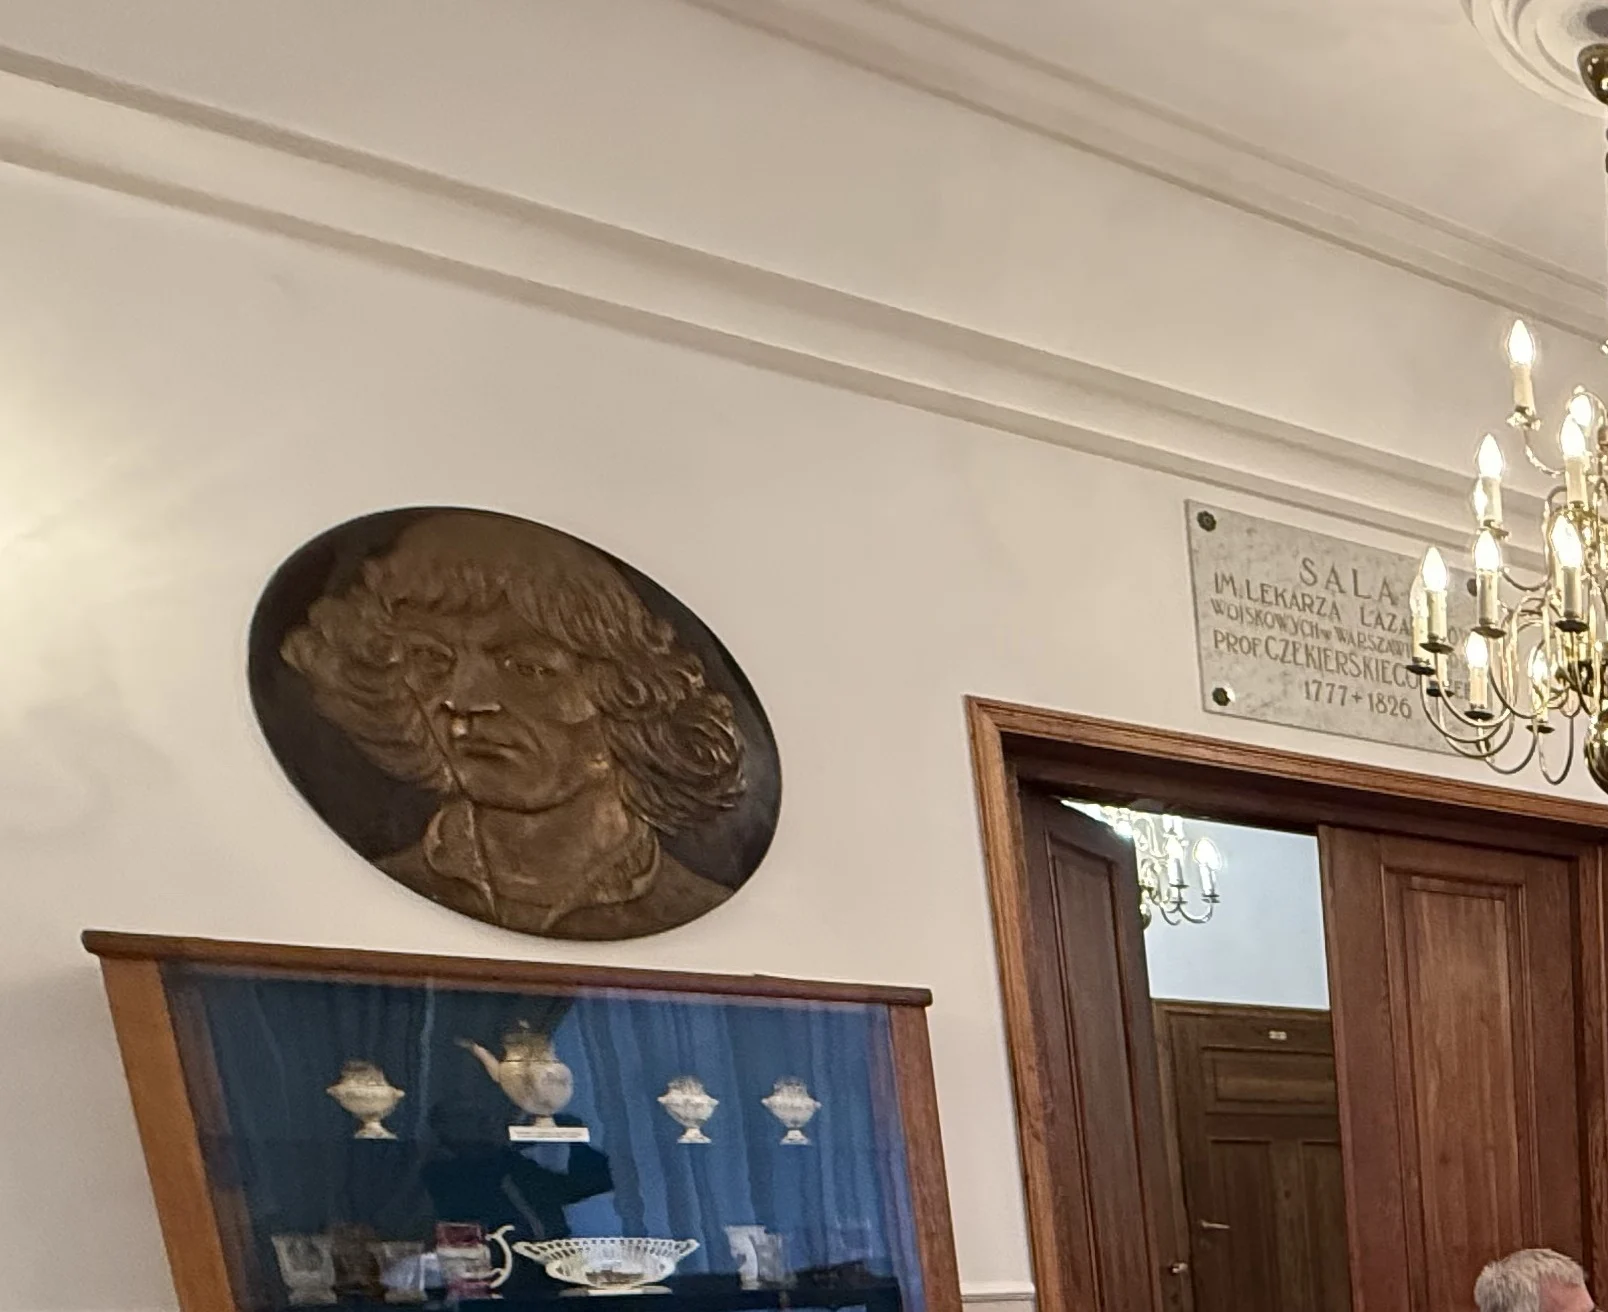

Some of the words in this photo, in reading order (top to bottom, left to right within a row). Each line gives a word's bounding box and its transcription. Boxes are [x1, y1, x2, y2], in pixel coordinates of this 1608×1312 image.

[1246, 579, 1341, 622] LEKARZA
[1300, 557, 1398, 606] SALA
[1304, 679, 1348, 706] 1777
[1367, 691, 1413, 720] 1826
